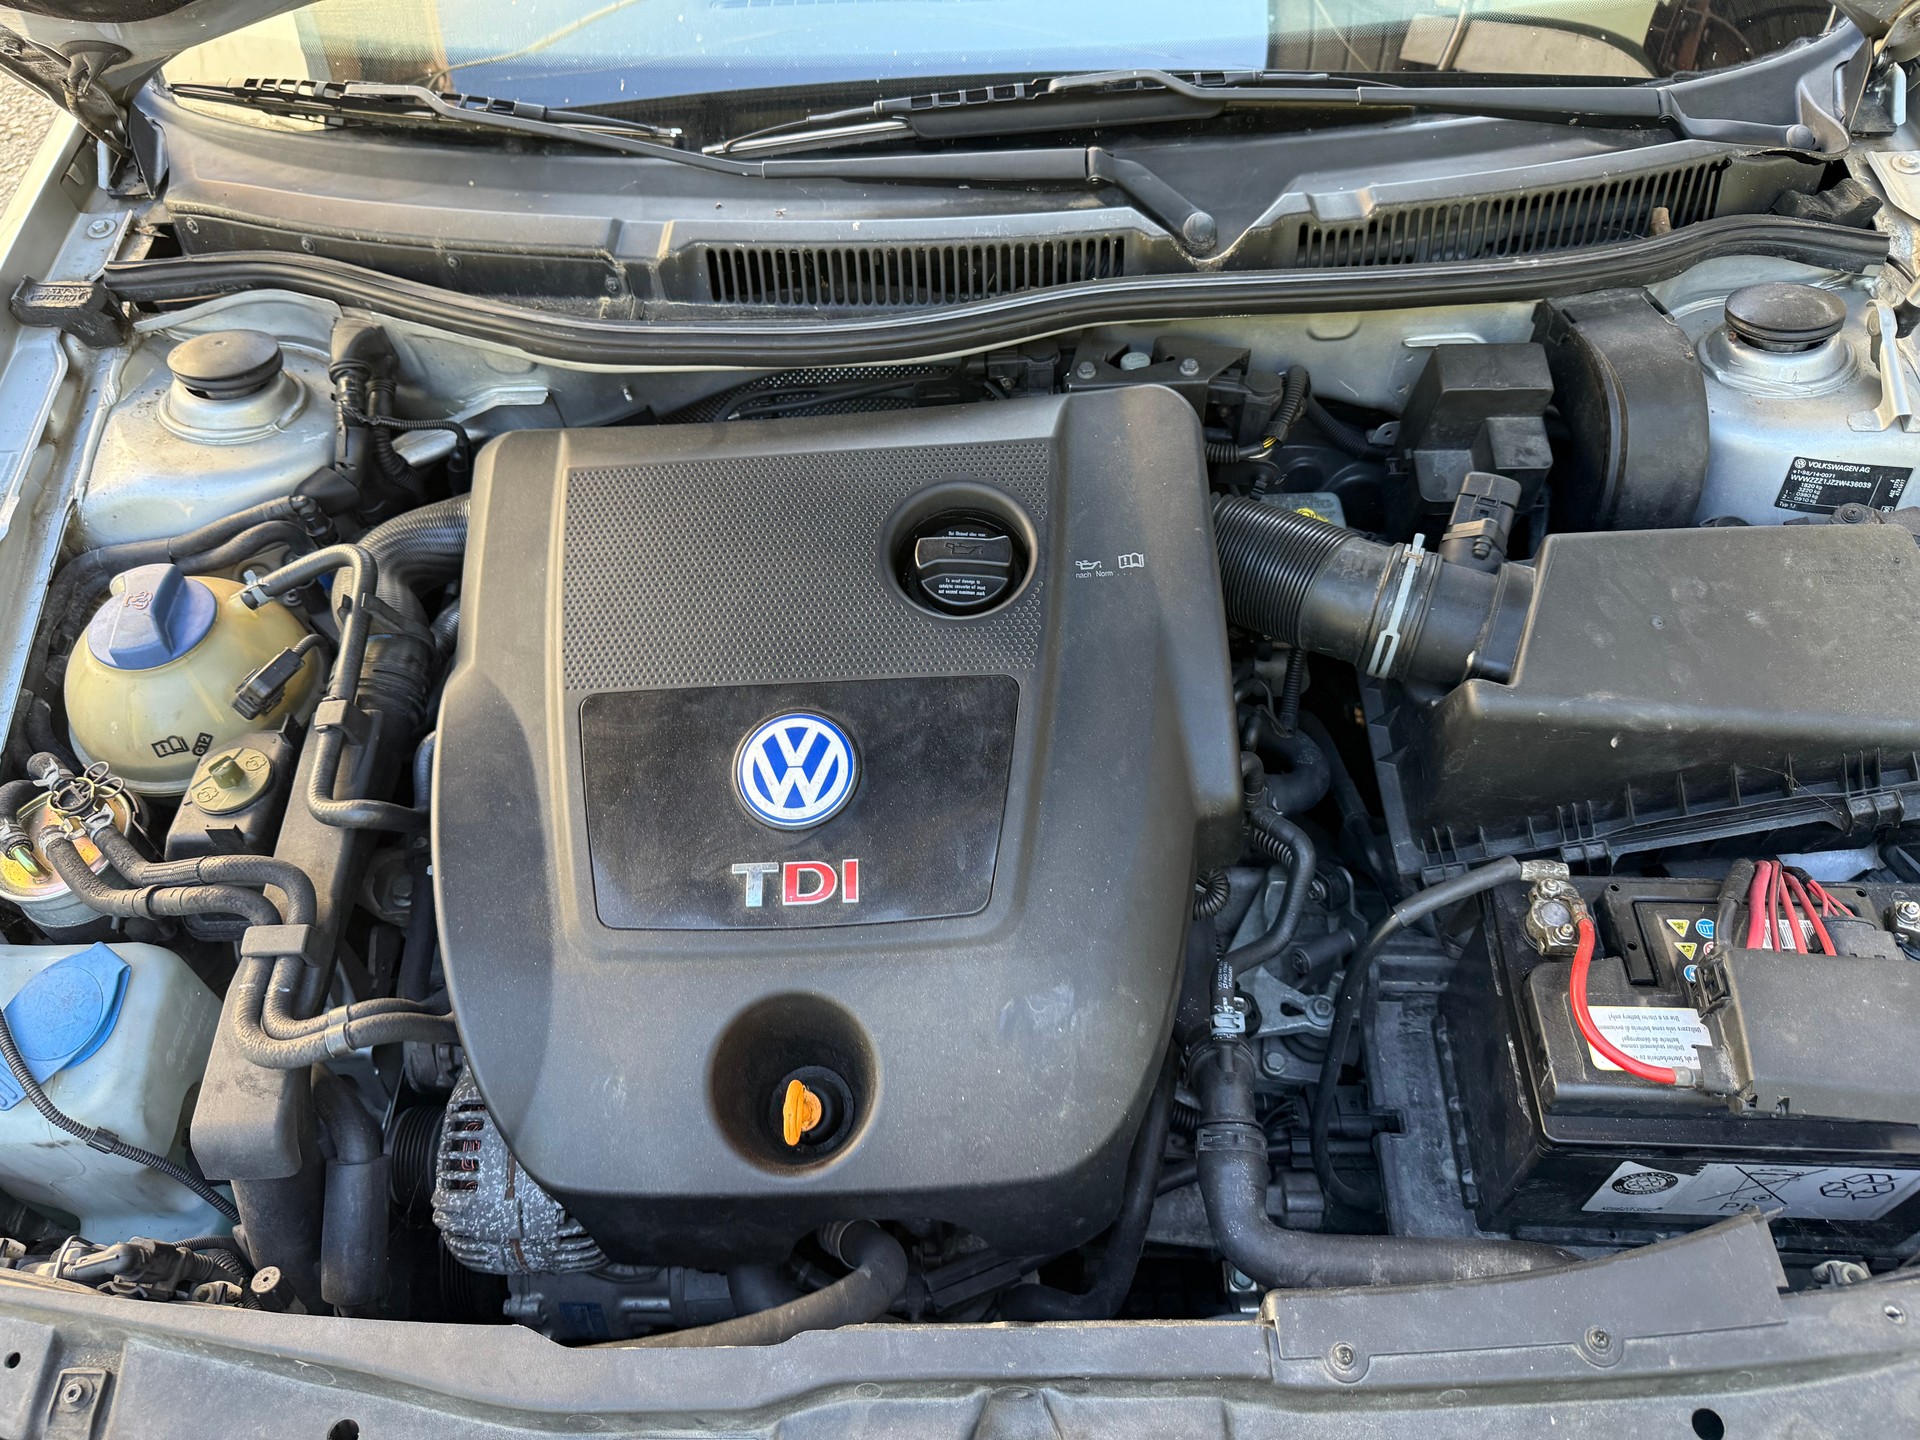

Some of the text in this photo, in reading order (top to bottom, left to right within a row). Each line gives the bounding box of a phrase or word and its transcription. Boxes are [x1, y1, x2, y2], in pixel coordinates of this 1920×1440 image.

[1808, 461, 1871, 474] VOLKSWAGEN AG
[1075, 571, 1092, 579] nach
[1095, 570, 1114, 578] Norm
[195, 735, 211, 755] G12
[741, 716, 850, 822] VW
[731, 858, 859, 907] TDI
